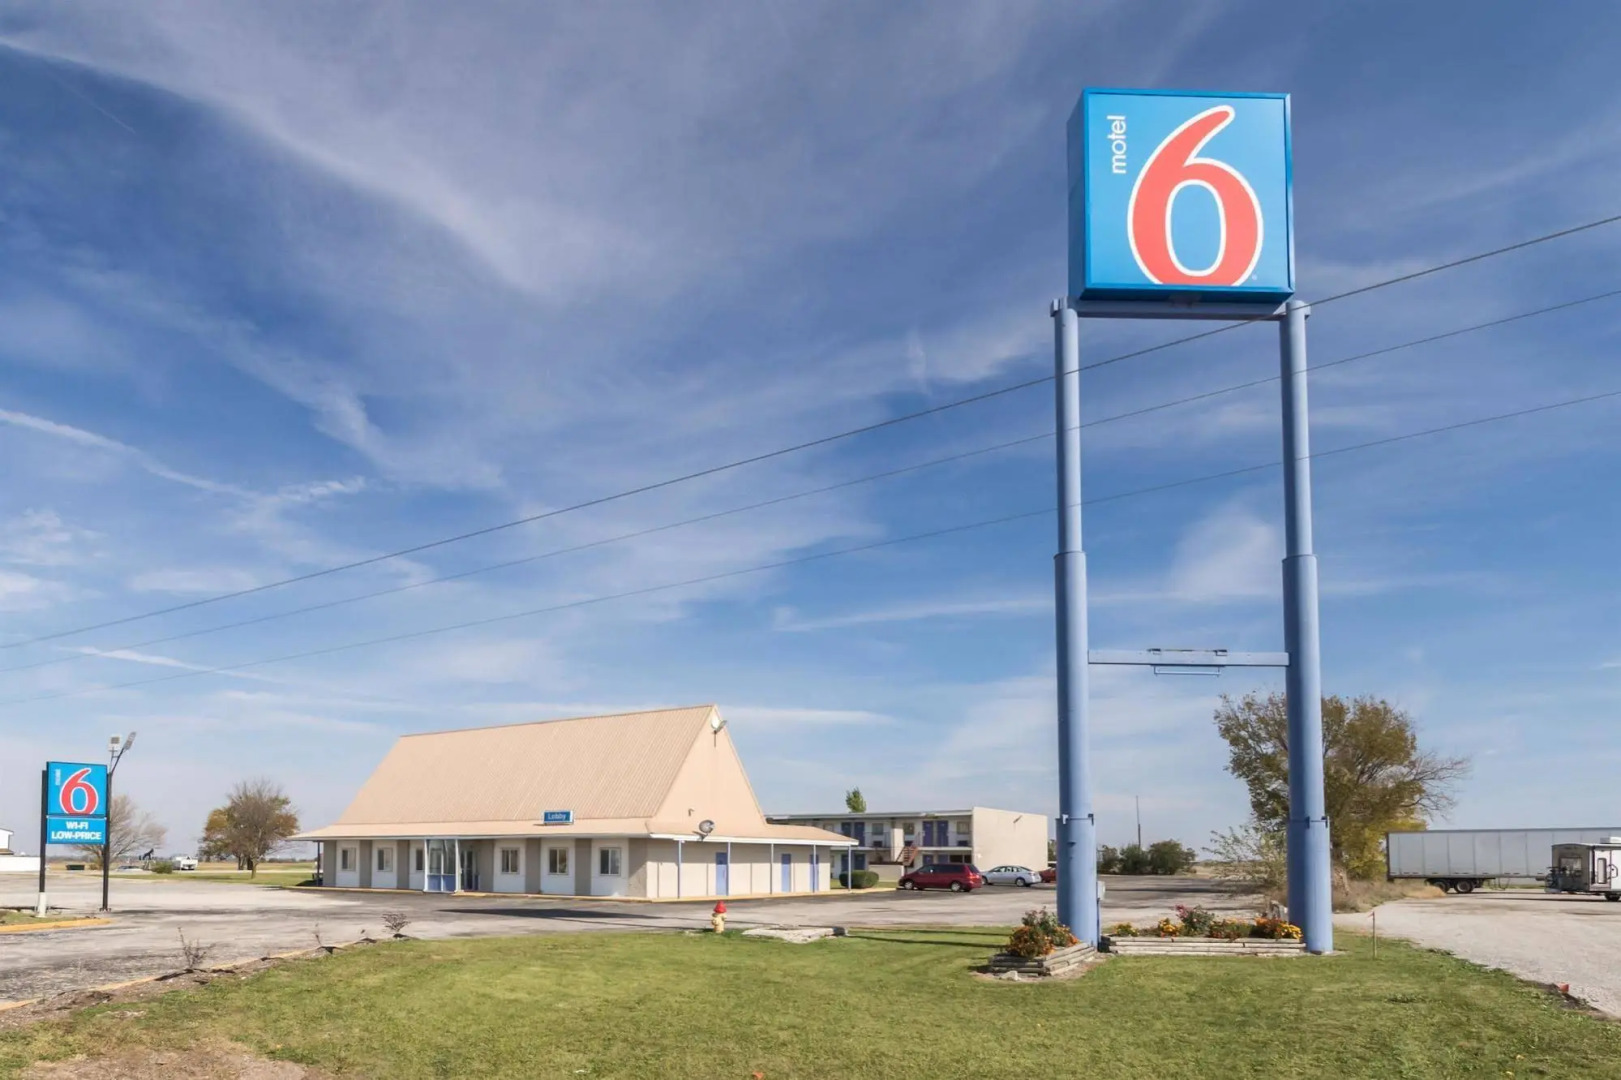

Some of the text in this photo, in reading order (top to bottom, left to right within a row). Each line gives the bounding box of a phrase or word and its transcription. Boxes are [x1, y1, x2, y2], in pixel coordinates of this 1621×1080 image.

[1107, 115, 1126, 174] motel
[1127, 105, 1264, 286] 6
[60, 768, 98, 814] 6
[66, 822, 88, 830] WI-FI
[548, 813, 566, 821] Lobby
[51, 830, 101, 840] LOW-PRICE
